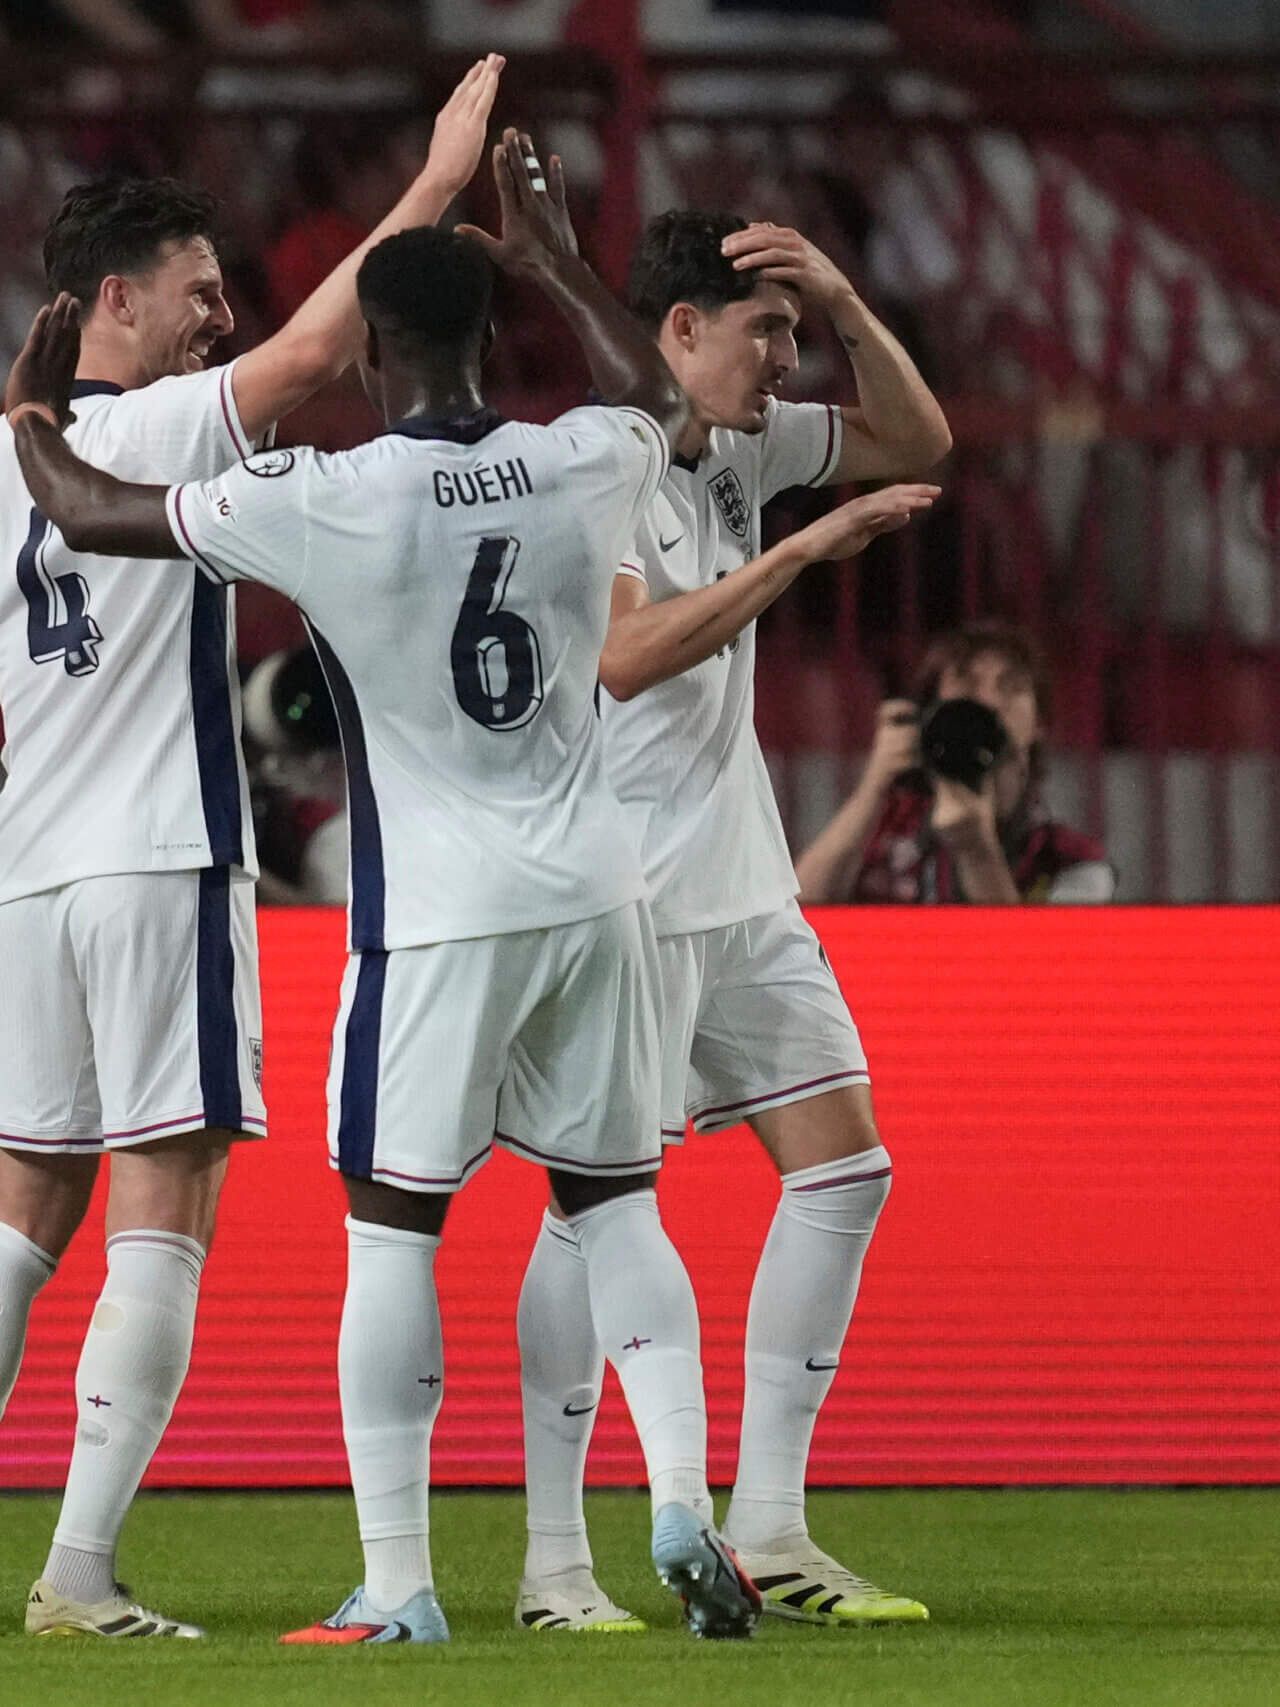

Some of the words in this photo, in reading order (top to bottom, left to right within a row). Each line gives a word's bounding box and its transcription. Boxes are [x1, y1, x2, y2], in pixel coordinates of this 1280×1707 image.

[432, 457, 534, 508] GUÉHI
[16, 505, 104, 677] 4
[450, 535, 544, 733] 6
